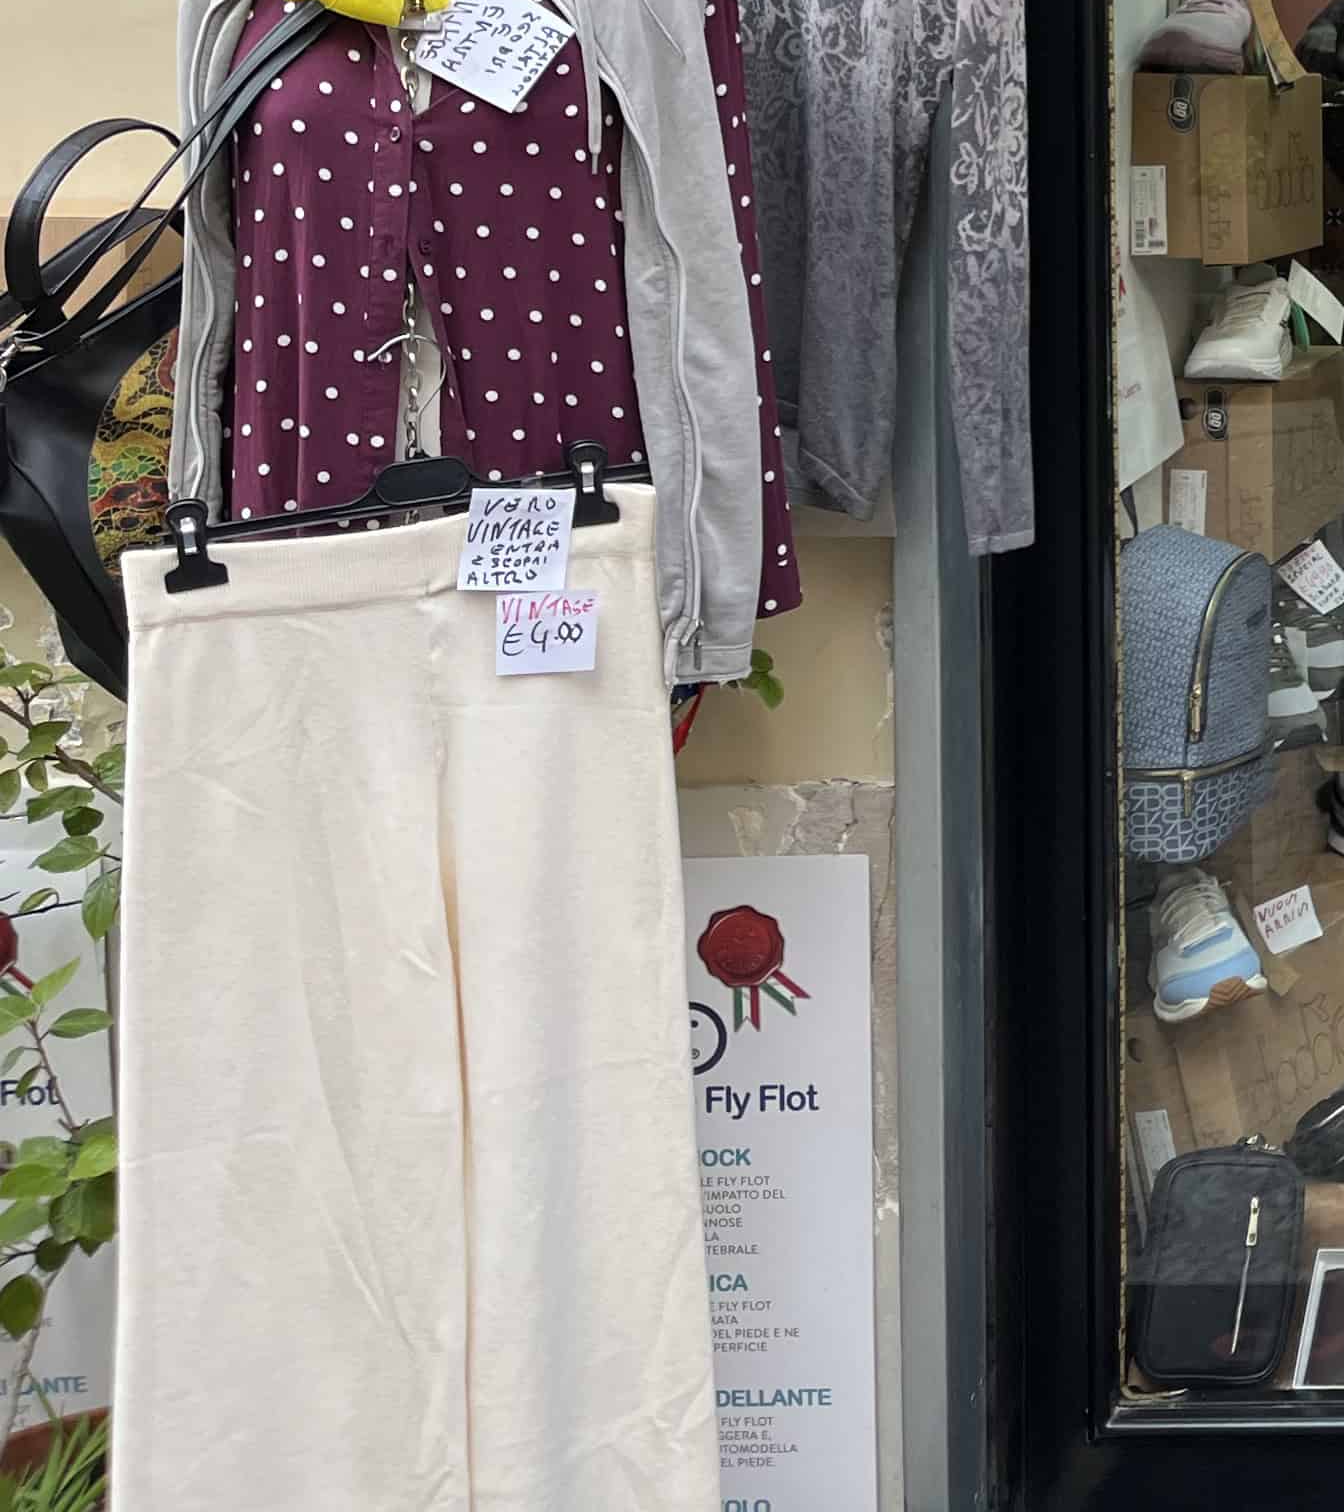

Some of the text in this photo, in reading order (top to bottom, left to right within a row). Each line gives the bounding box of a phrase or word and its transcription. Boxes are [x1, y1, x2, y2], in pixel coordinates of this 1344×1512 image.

[467, 517, 560, 544] VINTAGE
[467, 569, 538, 586] ALTRO
[502, 594, 596, 624] VINTAGE
[705, 1084, 820, 1120] Fly Flot
[699, 1148, 752, 1168] OCK
[717, 1176, 738, 1187] FLY
[741, 1175, 771, 1186] FLOT
[703, 1189, 785, 1201] 'IMPATTO DEL
[705, 1244, 759, 1256] TEBRALE
[709, 1273, 749, 1292] ICA
[719, 1300, 772, 1312] FLY FLOT
[735, 1328, 770, 1339] PIEDE
[784, 1327, 800, 1338] NE
[713, 1341, 768, 1353] PERFICIE
[715, 1388, 833, 1408] DELLANTE
[720, 1416, 774, 1428] FLY FLOT
[720, 1444, 799, 1454] TOMODELLA
[720, 1457, 734, 1468] EL
